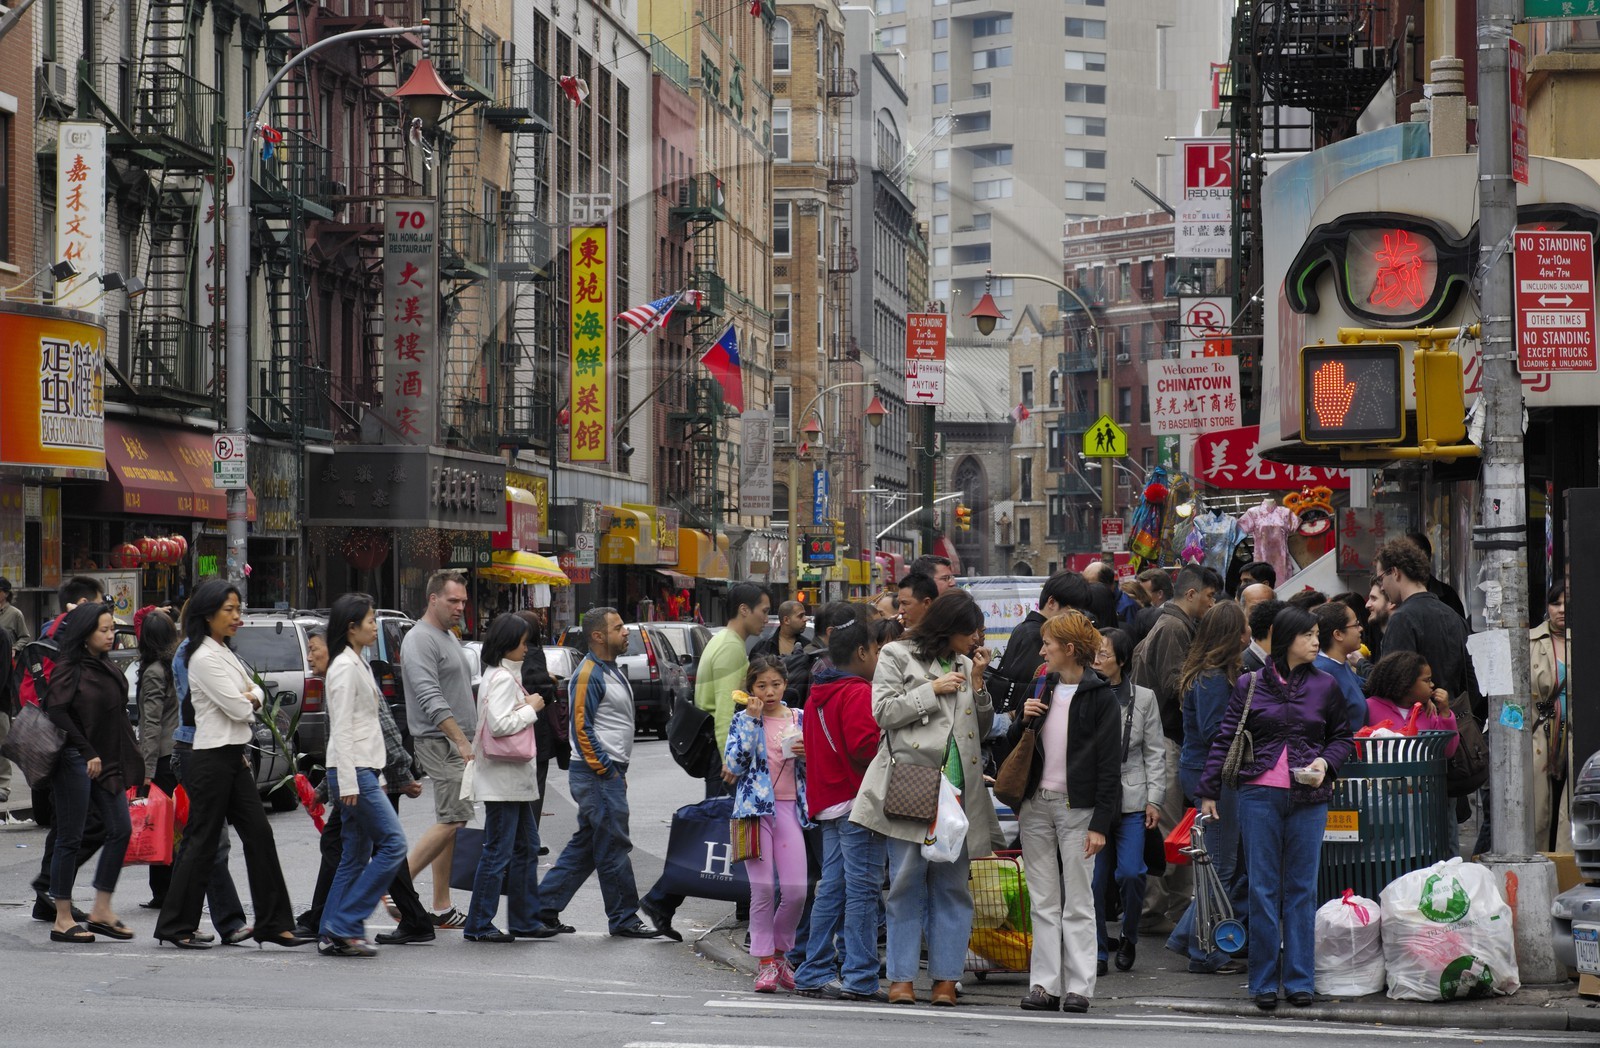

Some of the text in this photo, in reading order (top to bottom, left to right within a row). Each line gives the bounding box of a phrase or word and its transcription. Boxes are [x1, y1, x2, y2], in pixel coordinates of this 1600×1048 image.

[1188, 189, 1208, 197] RED
[395, 211, 426, 229] 70
[388, 232, 433, 242] TAI HONG LAU
[389, 244, 432, 254] RESTAURANT
[1520, 237, 1587, 252] NO STANDING
[1537, 254, 1571, 265] 7AM-10AM
[1539, 267, 1570, 278] 4PM-7PM
[1526, 282, 1583, 291] INCLUDING SUNDAY
[910, 317, 943, 328] NO STANDING
[1531, 315, 1582, 325] OTHER TIMES
[574, 236, 604, 451] 東苑海鮮菜館
[1523, 331, 1591, 345] NO STANDING
[394, 261, 426, 436] 大漢樓酒家
[1527, 347, 1588, 358] EXCEPT TRUCKS
[906, 361, 943, 376] NO PARKING
[1162, 362, 1225, 376] Welcome To
[1559, 359, 1593, 367] UNLOADING
[911, 381, 939, 390] ANYTIME
[1157, 376, 1231, 393] CHINATOWN
[1154, 393, 1237, 416] 美光地下商場
[1168, 418, 1208, 429] BASEMENT
[1210, 416, 1235, 427] STORE
[41, 415, 60, 442] EGG
[60, 417, 87, 445] CUSTARD
[700, 841, 734, 876] H
[700, 873, 733, 882] HILFIGER
